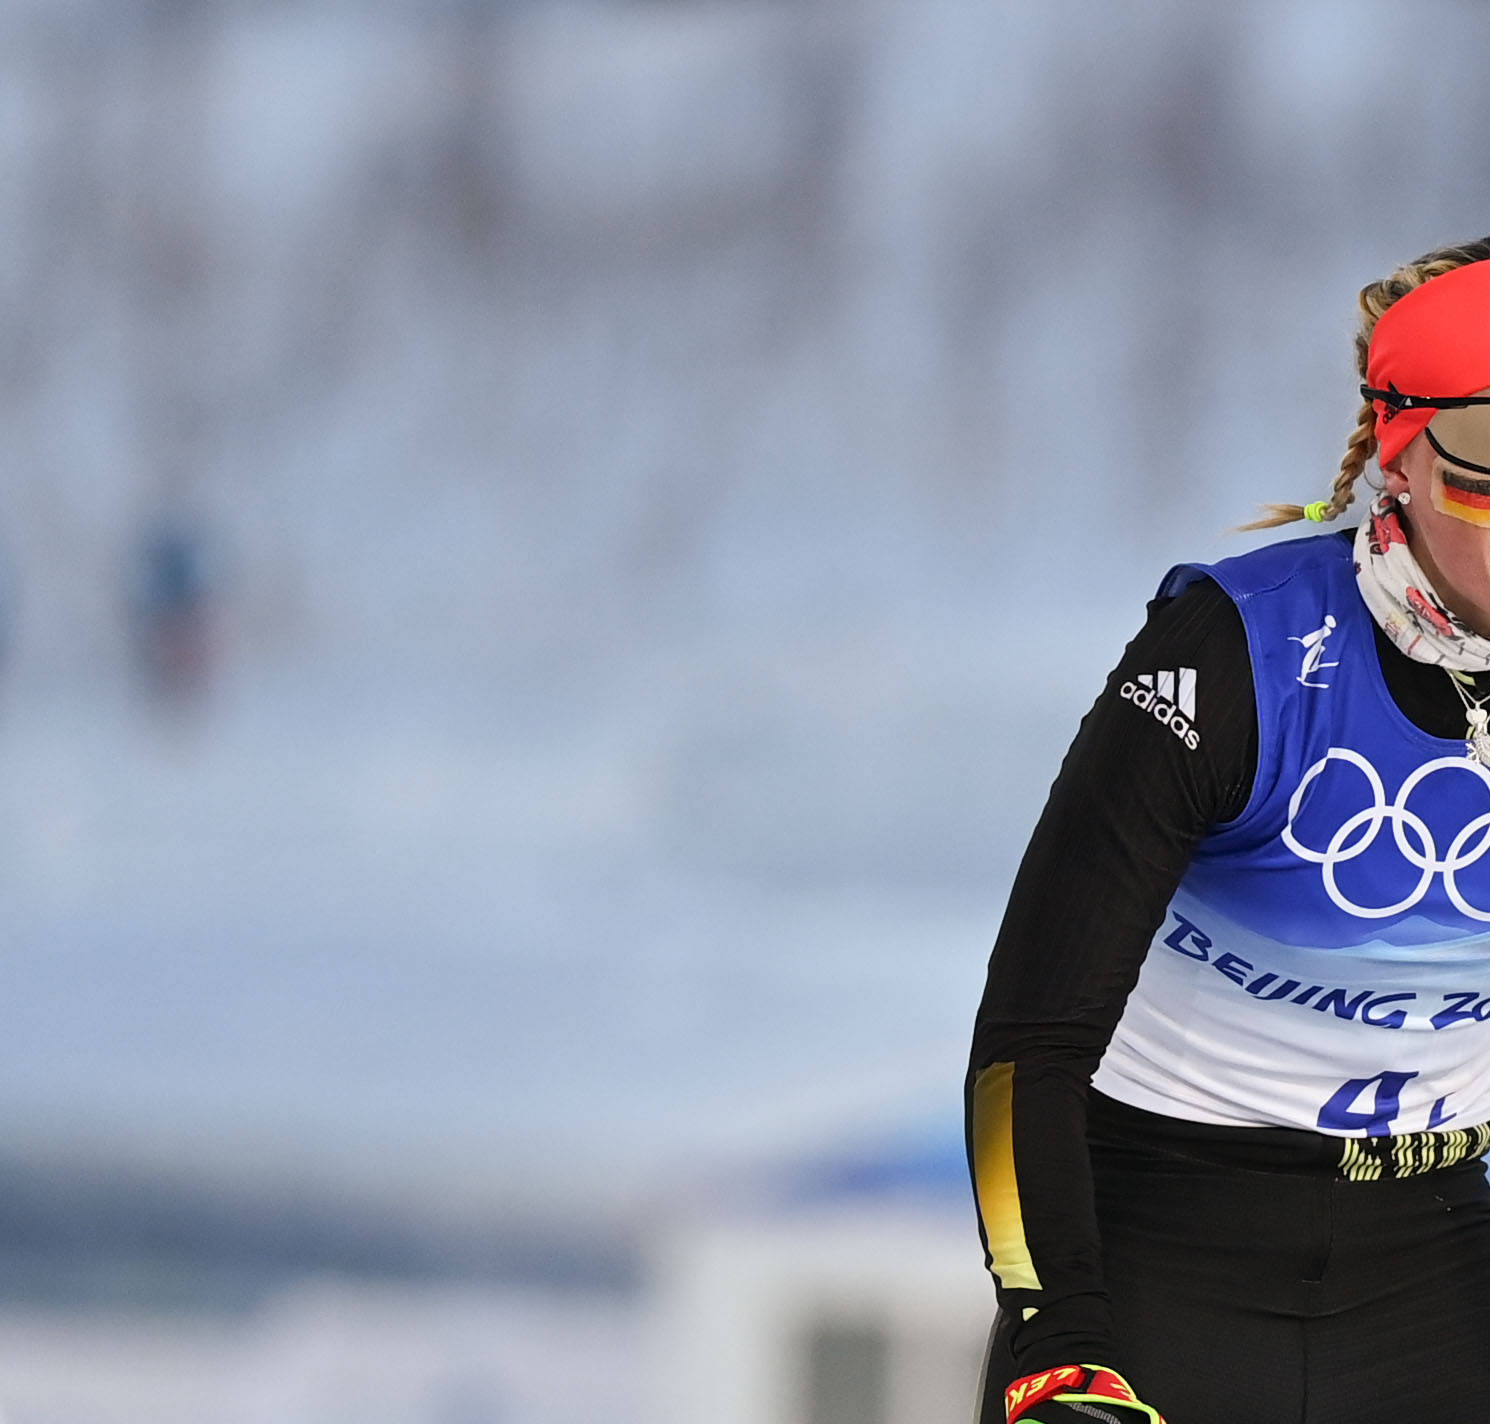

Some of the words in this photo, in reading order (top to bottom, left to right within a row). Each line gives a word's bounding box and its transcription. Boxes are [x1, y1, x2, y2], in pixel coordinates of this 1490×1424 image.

[1120, 681, 1200, 750] adidas
[1163, 909, 1416, 1030] BEIJING
[1317, 1070, 1420, 1137] 4
[1005, 1367, 1077, 1413] LEK
